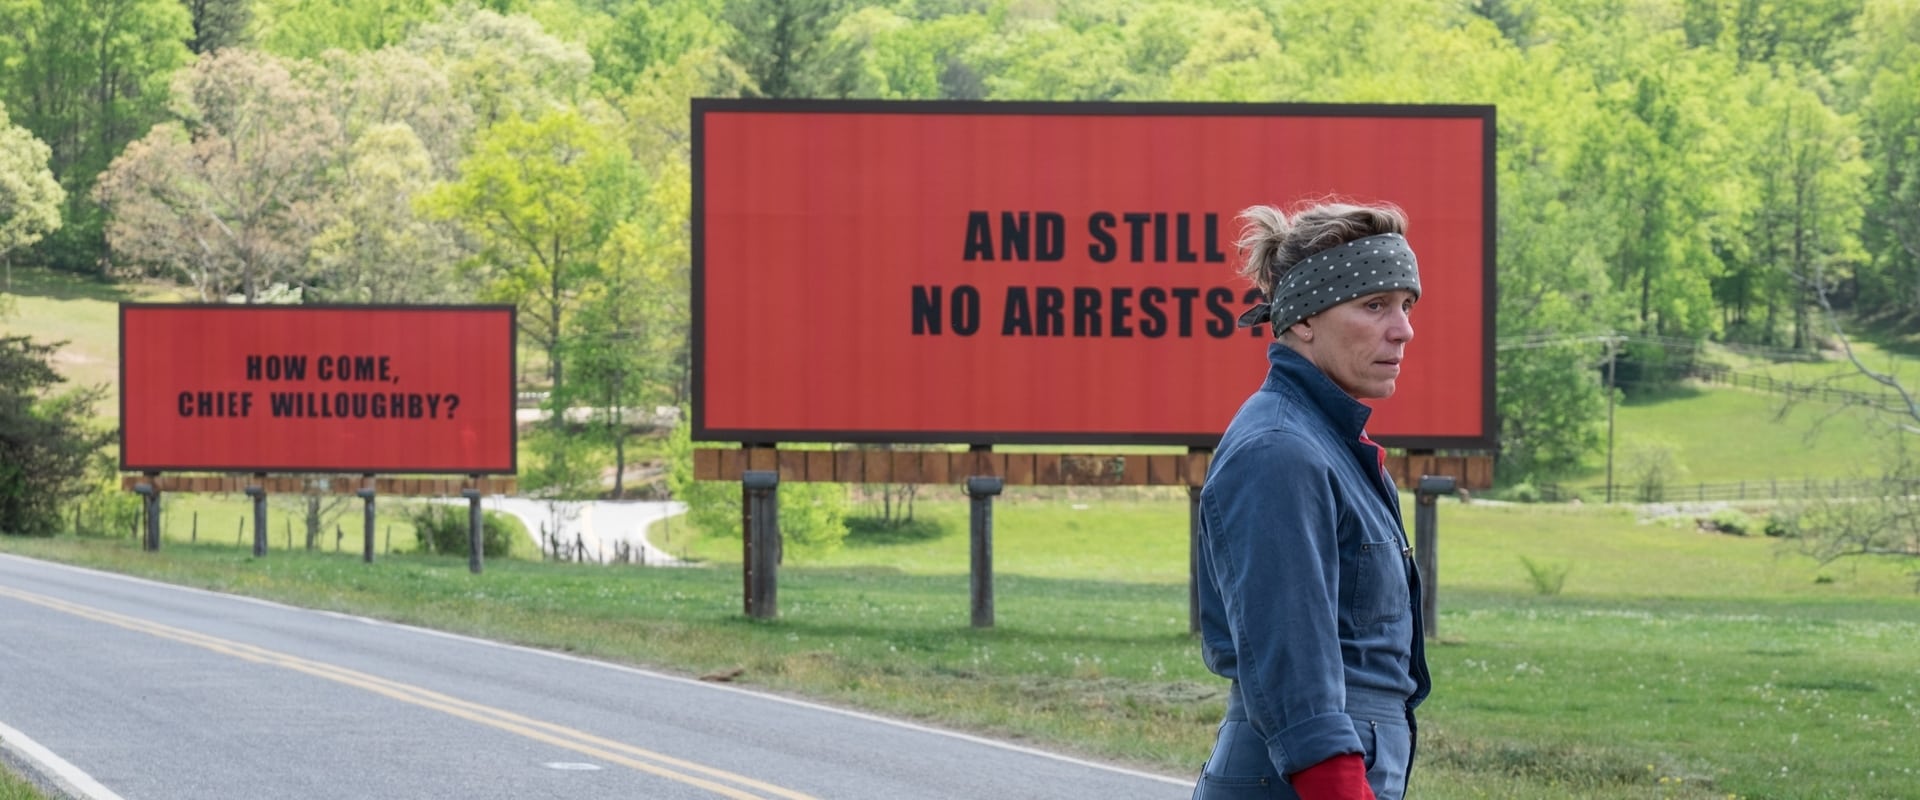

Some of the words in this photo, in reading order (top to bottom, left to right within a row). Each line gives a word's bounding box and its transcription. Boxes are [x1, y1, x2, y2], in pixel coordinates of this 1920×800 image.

[963, 211, 1065, 262] AND
[1087, 212, 1226, 263] STILL
[911, 285, 981, 337] NO
[246, 355, 307, 381] HOW
[317, 355, 399, 385] COME,
[178, 391, 252, 417] CHIEF
[270, 392, 460, 419] WILLOUGHBY?
